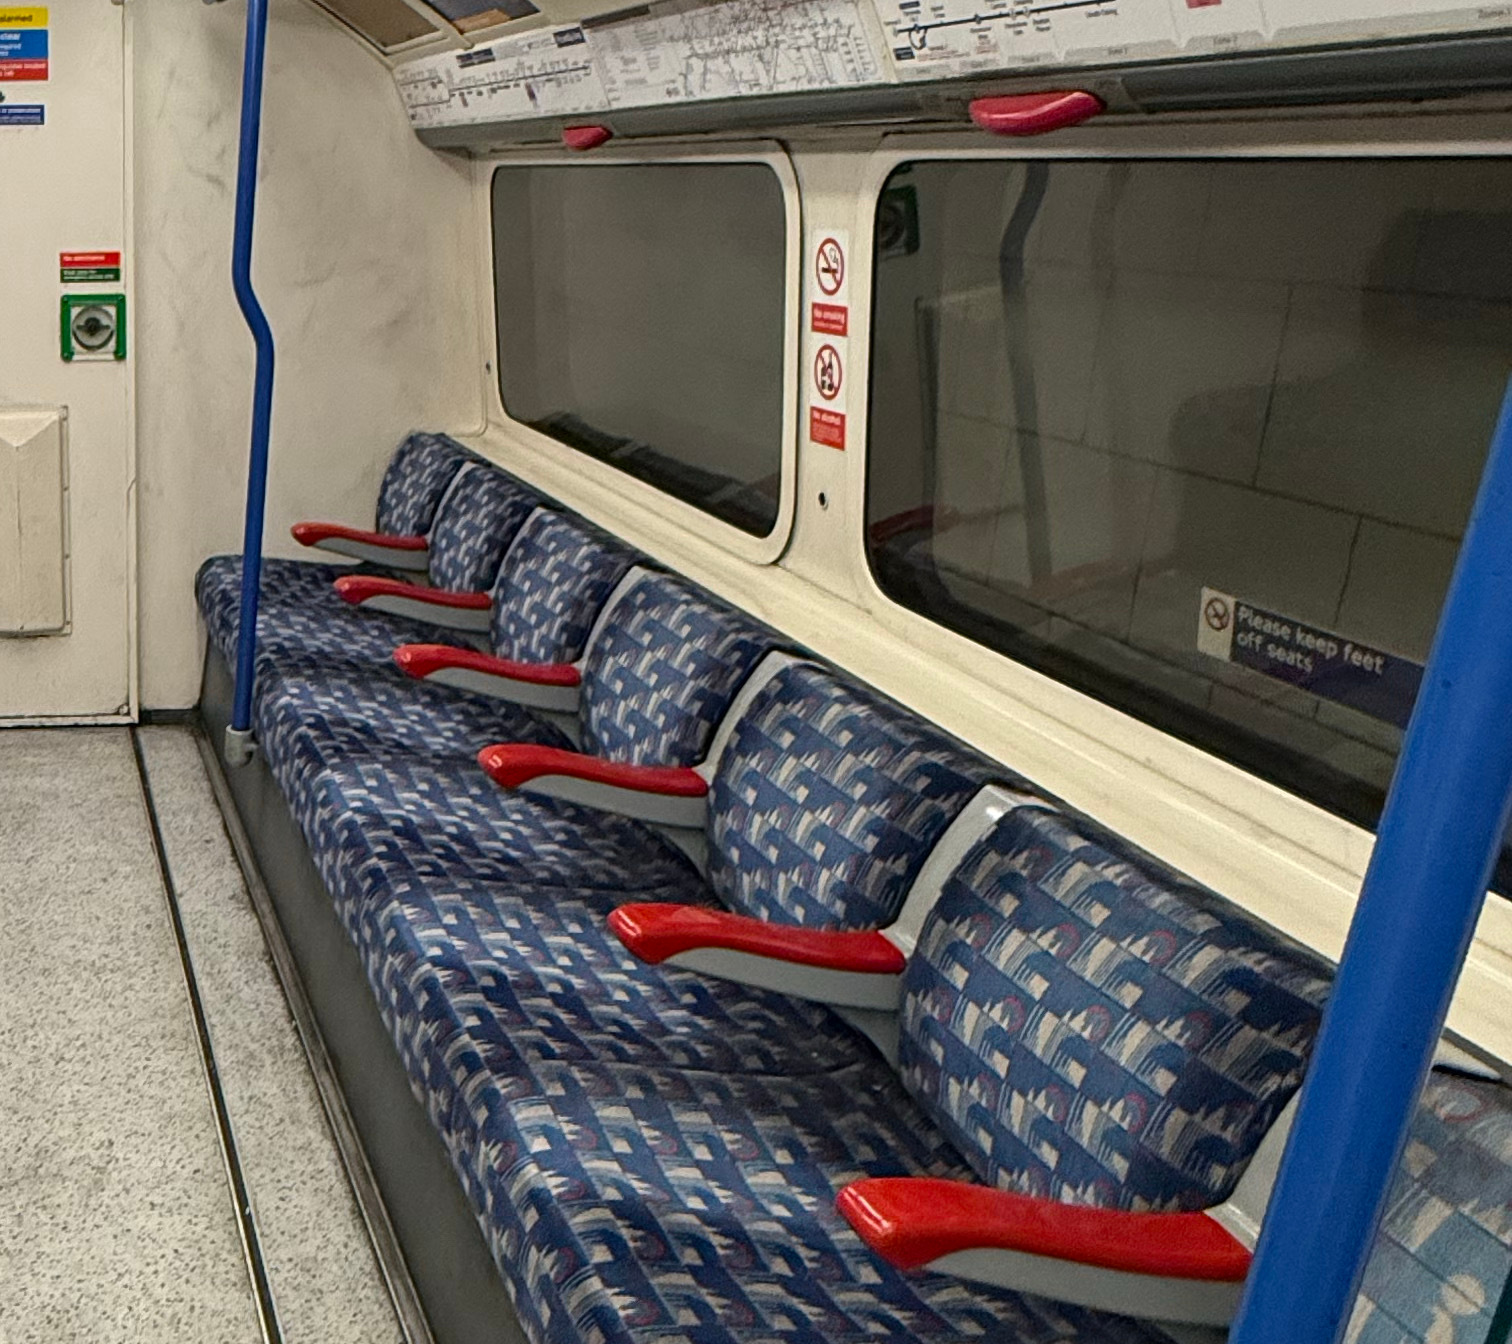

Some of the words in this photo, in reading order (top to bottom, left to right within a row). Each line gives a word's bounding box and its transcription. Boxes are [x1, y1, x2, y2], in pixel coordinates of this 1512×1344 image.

[0, 14, 33, 23] alarmed
[0, 32, 21, 41] clear
[1236, 631, 1263, 653] off
[1266, 642, 1314, 674] seats
[1237, 605, 1292, 641] Please
[1295, 626, 1339, 660] keep
[1343, 643, 1386, 676] feet
